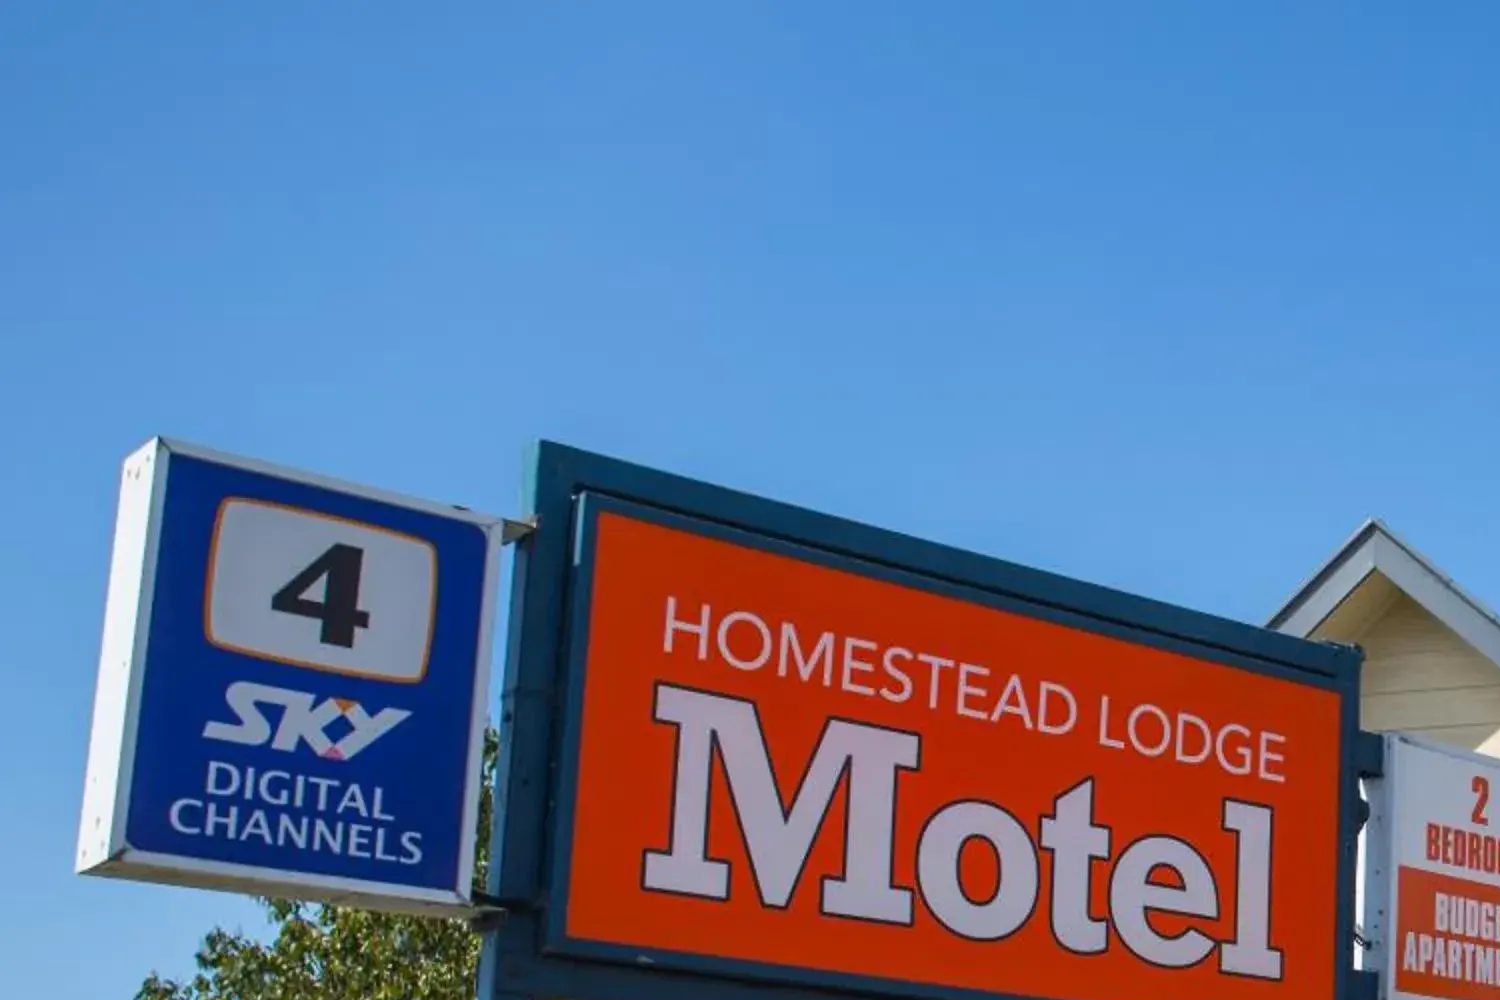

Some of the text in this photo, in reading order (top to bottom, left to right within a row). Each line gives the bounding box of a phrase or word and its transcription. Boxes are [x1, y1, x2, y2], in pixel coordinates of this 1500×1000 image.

[271, 543, 370, 648] 4
[202, 680, 413, 760] SKY
[661, 596, 1286, 783] HOMESTEAD LODGE
[205, 760, 395, 821] DIGITAL
[1471, 775, 1489, 826] 2
[169, 798, 422, 865] CHANNELS
[641, 681, 1283, 982] Motel
